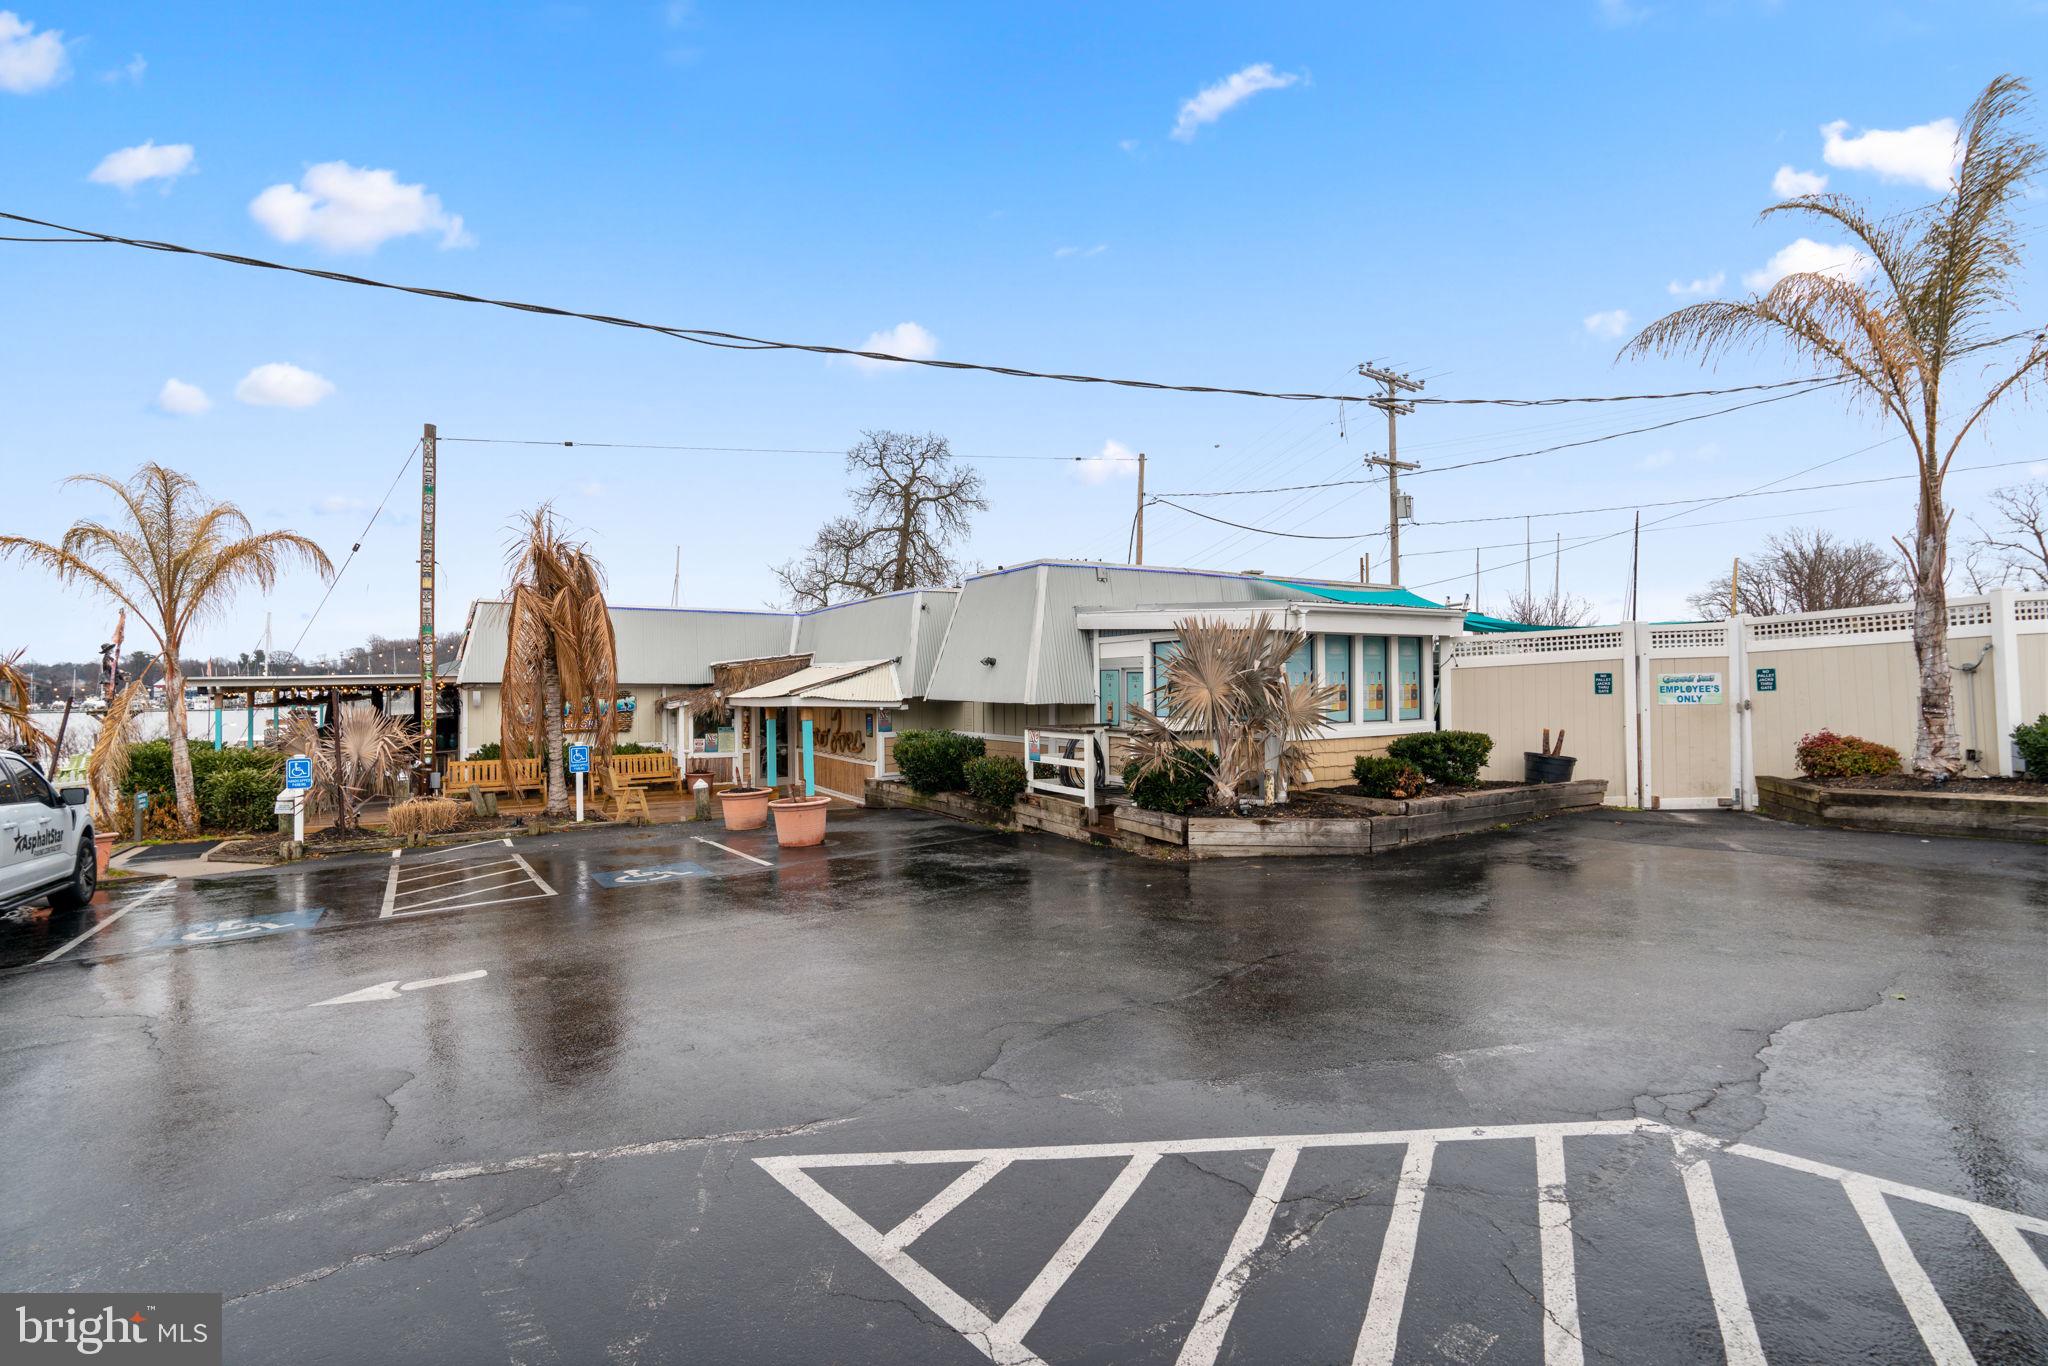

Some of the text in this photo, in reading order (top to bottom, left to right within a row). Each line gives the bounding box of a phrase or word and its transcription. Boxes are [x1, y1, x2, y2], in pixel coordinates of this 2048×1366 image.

[1660, 685, 1720, 693] EMPLOYEE'S
[1676, 695, 1702, 703] ONLY
[21, 829, 63, 853] AsphaltStar
